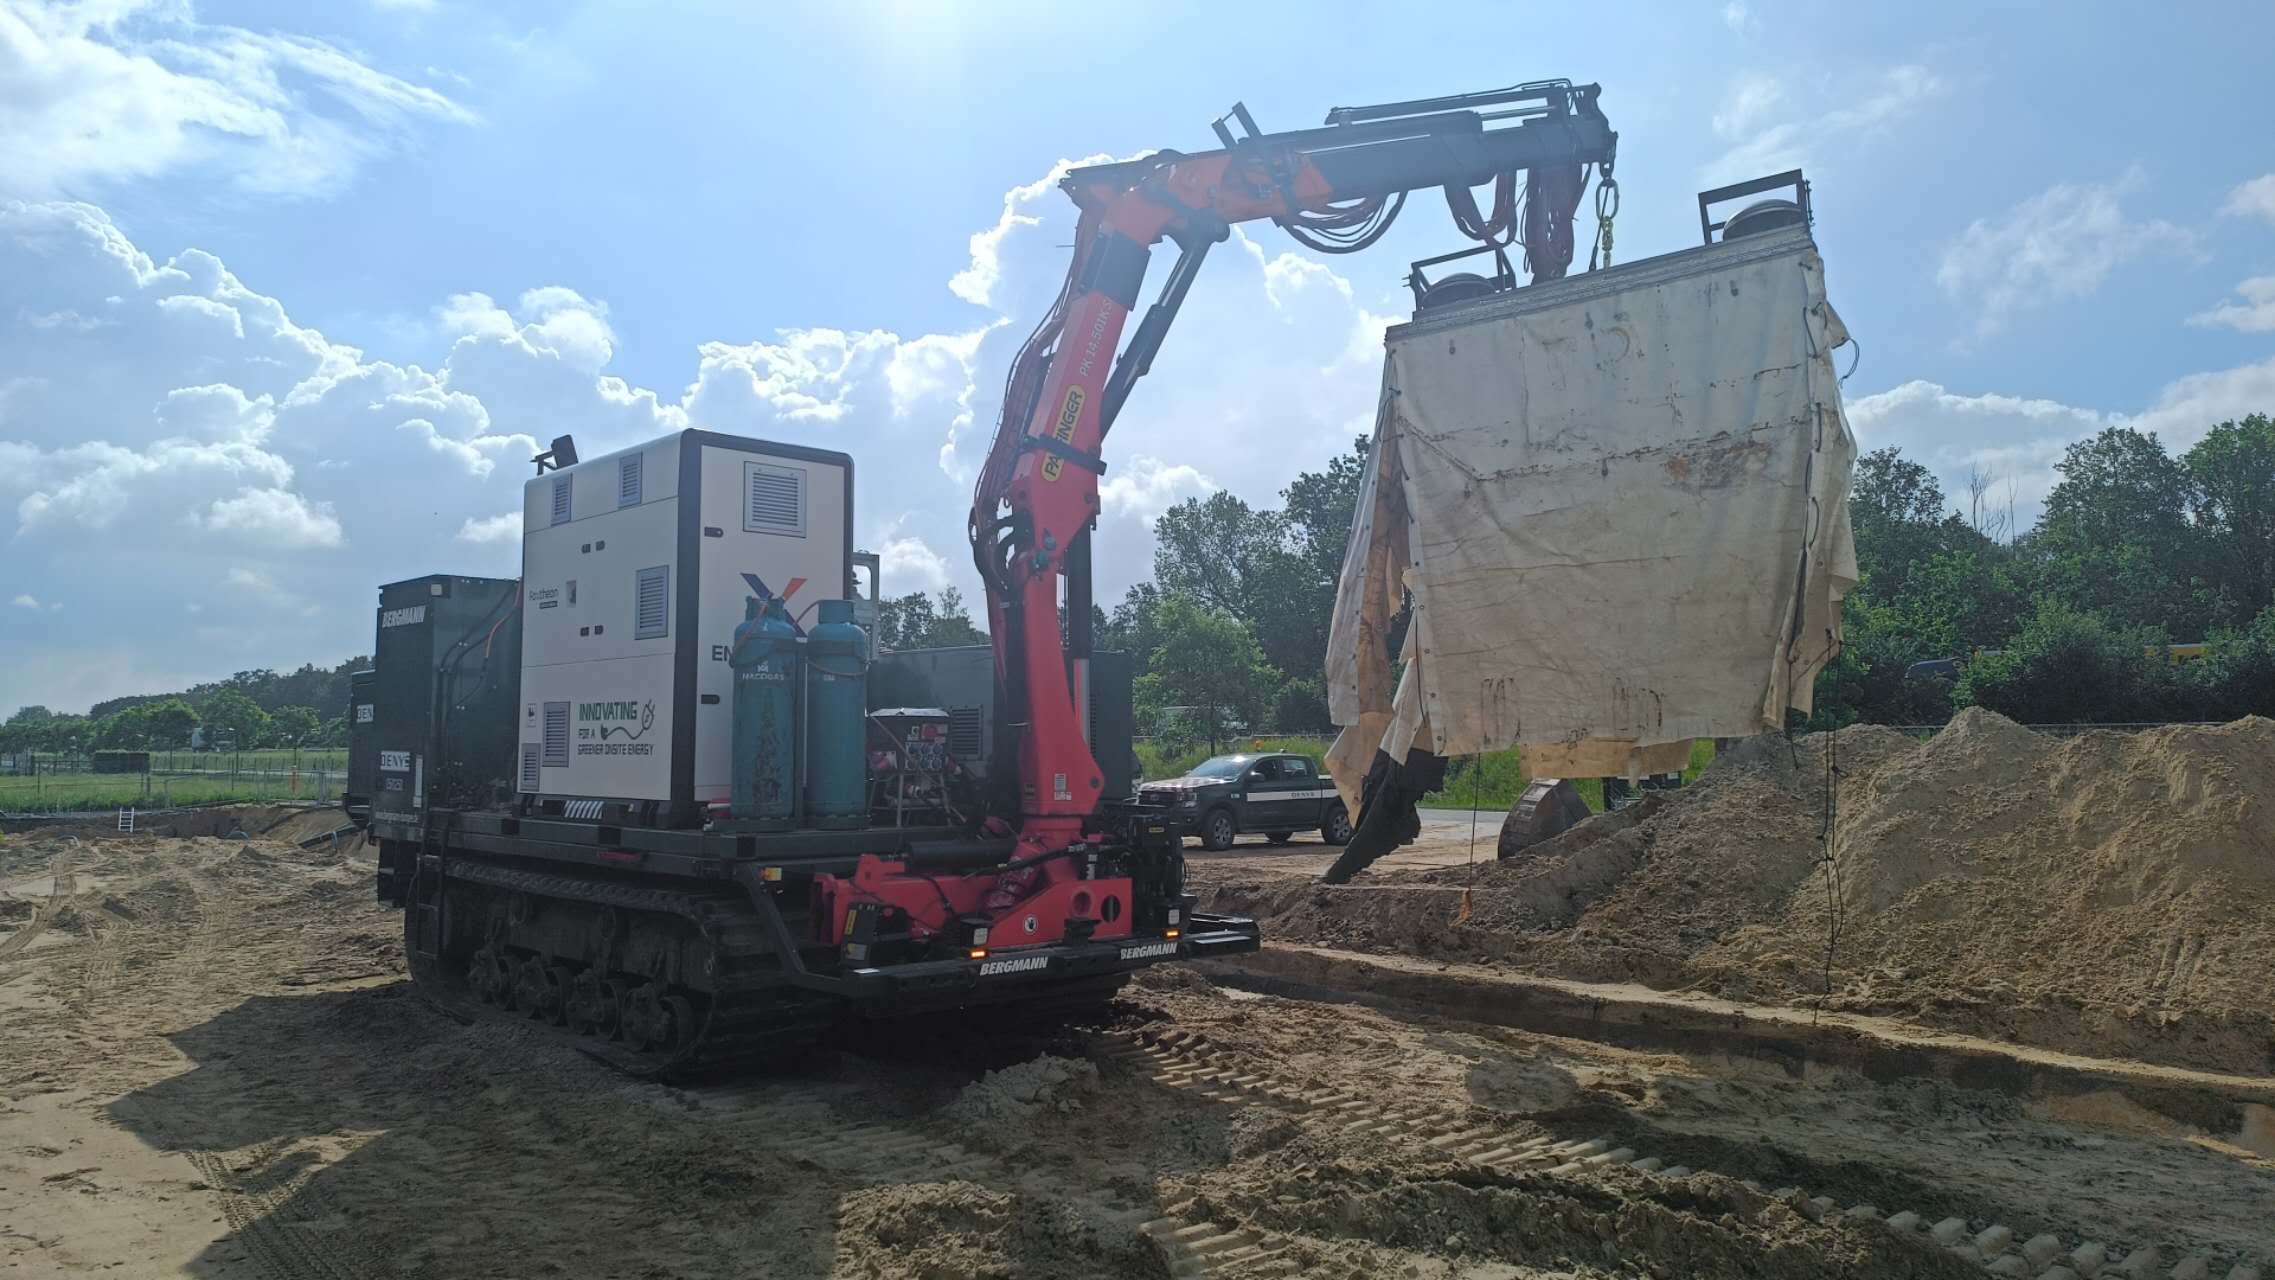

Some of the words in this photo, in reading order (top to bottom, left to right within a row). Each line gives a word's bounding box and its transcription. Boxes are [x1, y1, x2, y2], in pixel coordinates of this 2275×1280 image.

[1044, 390, 1083, 477] PAINGER
[382, 605, 426, 628] BERGMANN
[357, 706, 374, 721] DEN
[579, 701, 638, 720] INNOVATING
[577, 743, 603, 756] GREENER
[604, 743, 626, 755] ONSITE
[627, 743, 655, 756] ENERGY
[1120, 942, 1178, 960] BERGMANN
[980, 956, 1048, 976] BERGMANN
